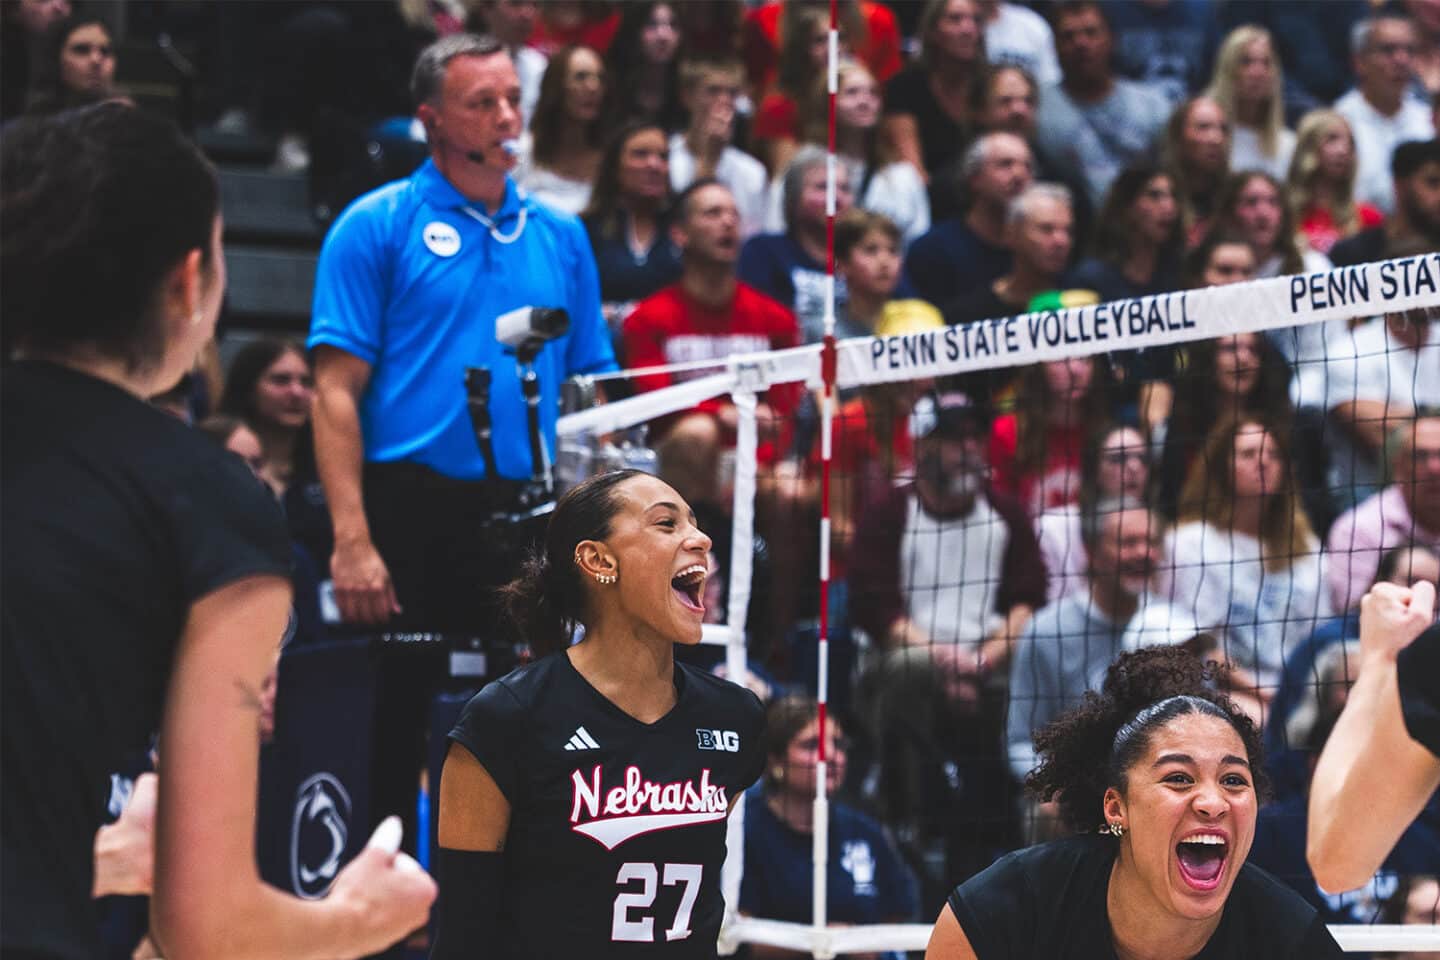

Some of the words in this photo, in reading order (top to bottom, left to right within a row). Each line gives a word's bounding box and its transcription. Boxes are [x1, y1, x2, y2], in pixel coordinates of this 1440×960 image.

[1290, 266, 1370, 313] PENN
[871, 335, 937, 371] PENN
[944, 321, 1020, 362] STATE
[1027, 294, 1196, 349] VOLLEYBALL
[571, 765, 728, 823] Nebraska
[611, 861, 704, 943] 27
